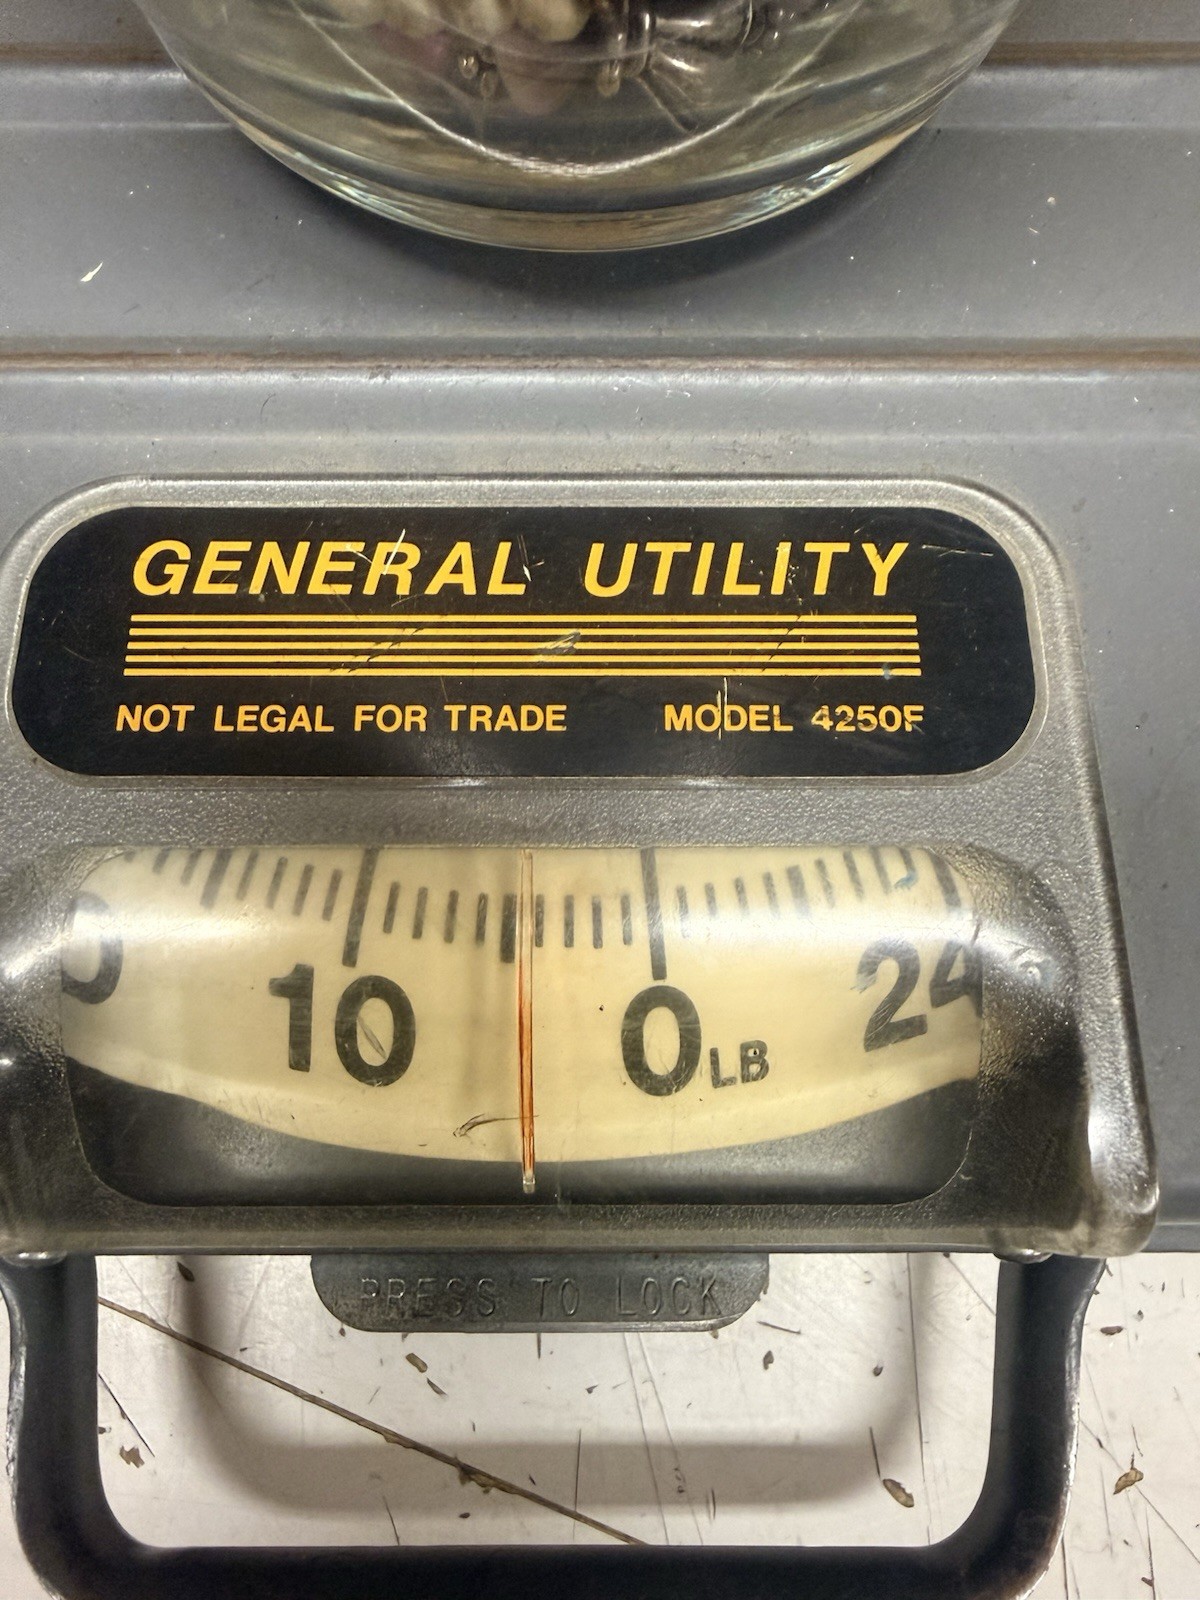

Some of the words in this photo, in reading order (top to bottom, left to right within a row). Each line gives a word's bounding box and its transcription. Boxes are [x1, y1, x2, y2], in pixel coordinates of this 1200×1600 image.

[132, 539, 529, 597] GENERAL
[583, 540, 909, 598] UTILITY
[115, 703, 193, 733] NOT
[213, 703, 334, 733] LEGAL
[353, 703, 427, 733] FOR
[445, 703, 567, 733] TRADE
[664, 703, 793, 733] MODEL
[808, 703, 924, 733] 4250F
[268, 963, 417, 1088] 10
[621, 983, 702, 1096] 0
[710, 1039, 769, 1084] LB
[360, 1277, 497, 1319] PRESS
[531, 1276, 581, 1317] TO
[616, 1273, 724, 1317] LOCK
